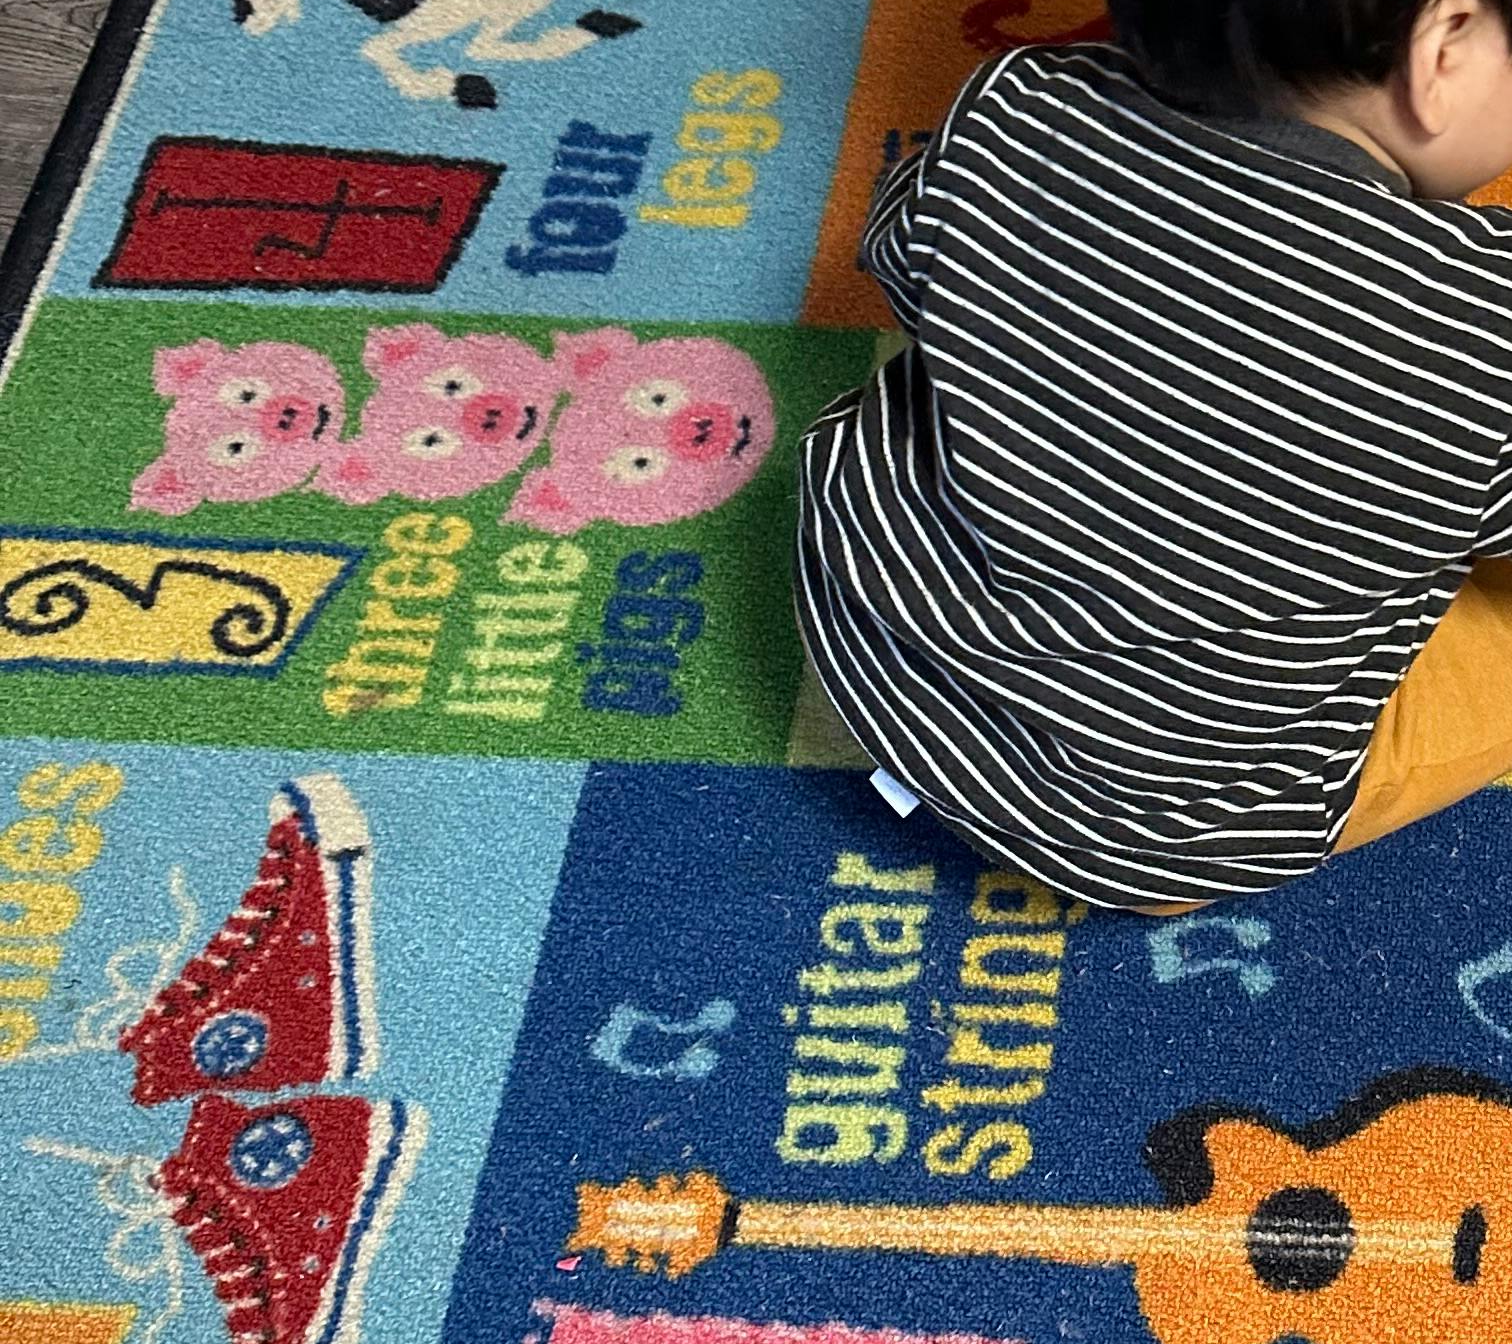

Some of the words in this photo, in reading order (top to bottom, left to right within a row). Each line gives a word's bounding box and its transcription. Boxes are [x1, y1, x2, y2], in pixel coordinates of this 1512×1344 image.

[148, 177, 445, 260] 4
[505, 119, 654, 276] four
[637, 68, 784, 228] legs
[0, 558, 292, 658] 3
[321, 511, 473, 717] three
[440, 542, 590, 720] little
[577, 550, 706, 719] pigs
[775, 851, 936, 1166] guitar
[921, 870, 1089, 1183] string
